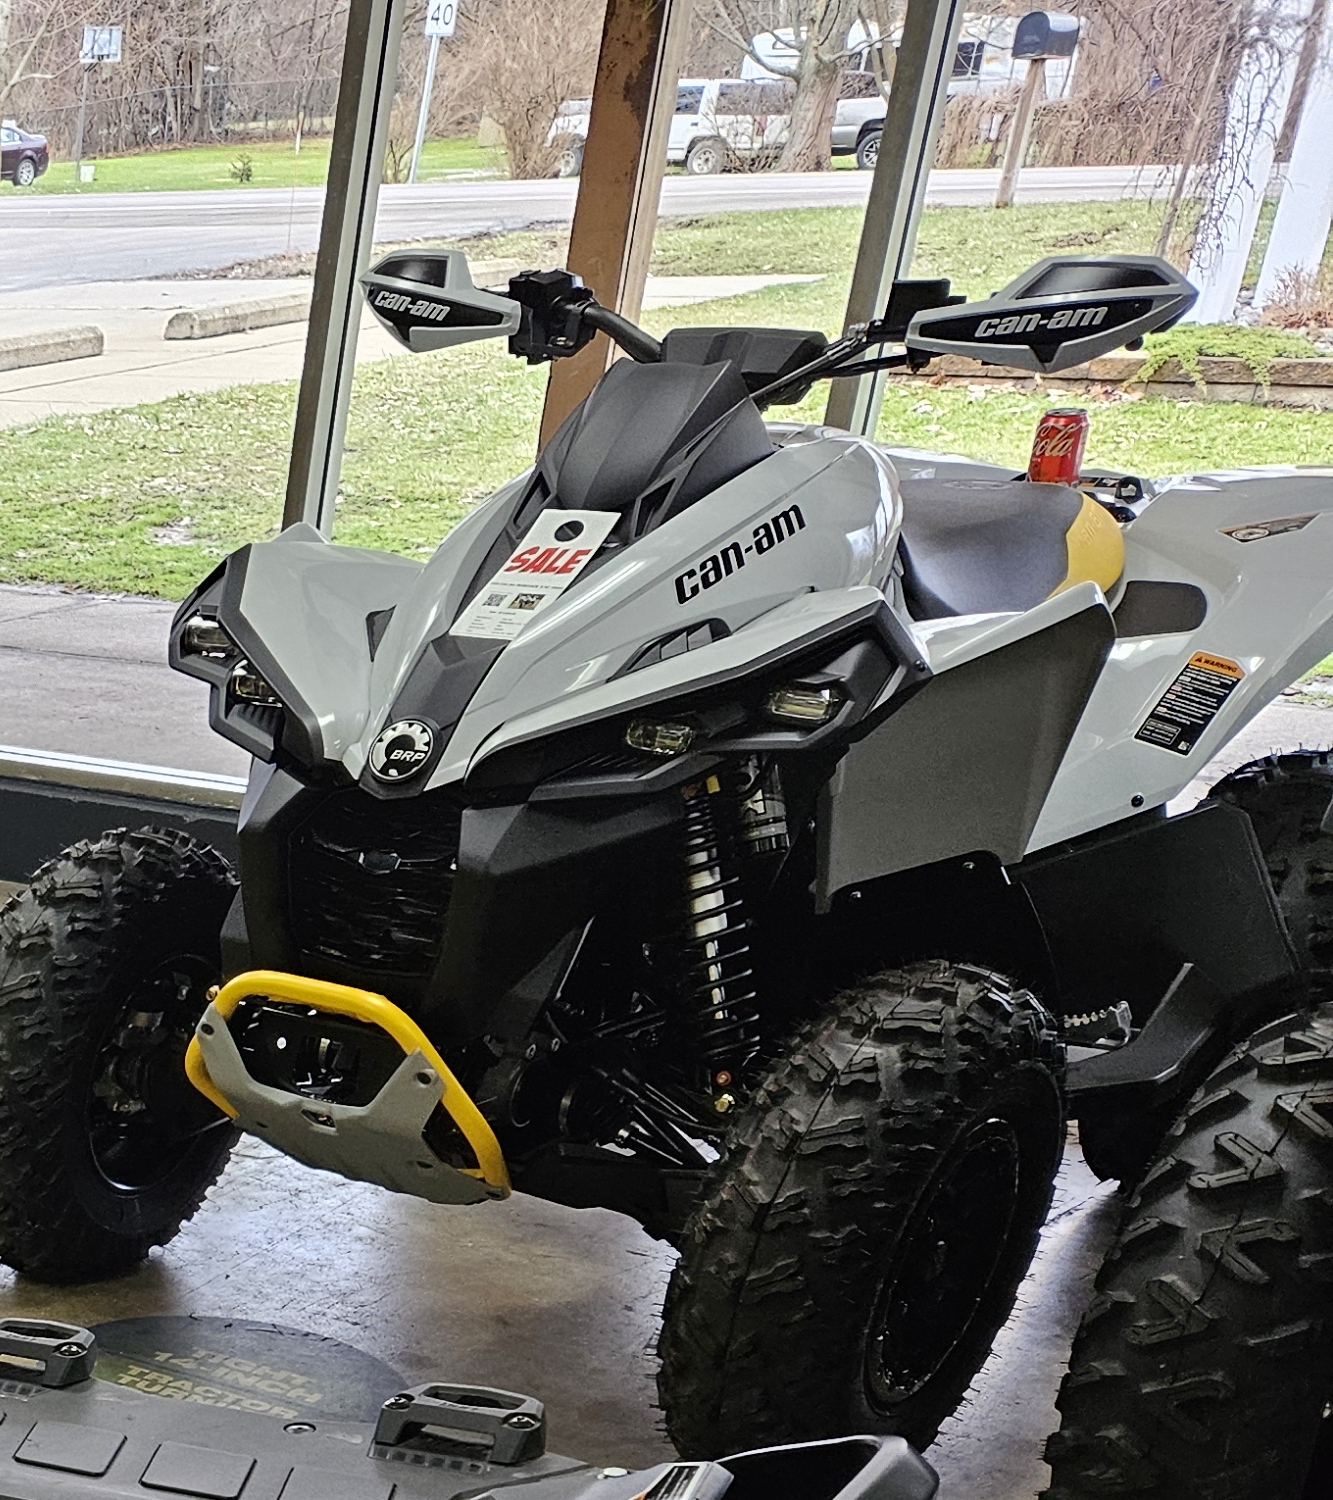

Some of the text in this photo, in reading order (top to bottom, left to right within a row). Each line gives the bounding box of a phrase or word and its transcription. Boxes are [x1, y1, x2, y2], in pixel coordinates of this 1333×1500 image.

[431, 3, 453, 25] 40
[374, 290, 451, 321] can-am
[974, 306, 1108, 338] can-am
[504, 546, 593, 575] SALE
[674, 504, 806, 605] can-am
[1204, 657, 1238, 673] WARNING
[390, 749, 426, 762] BRP
[127, 1365, 298, 1419] TRACTOR
[154, 1351, 323, 1403] 14-INCH
